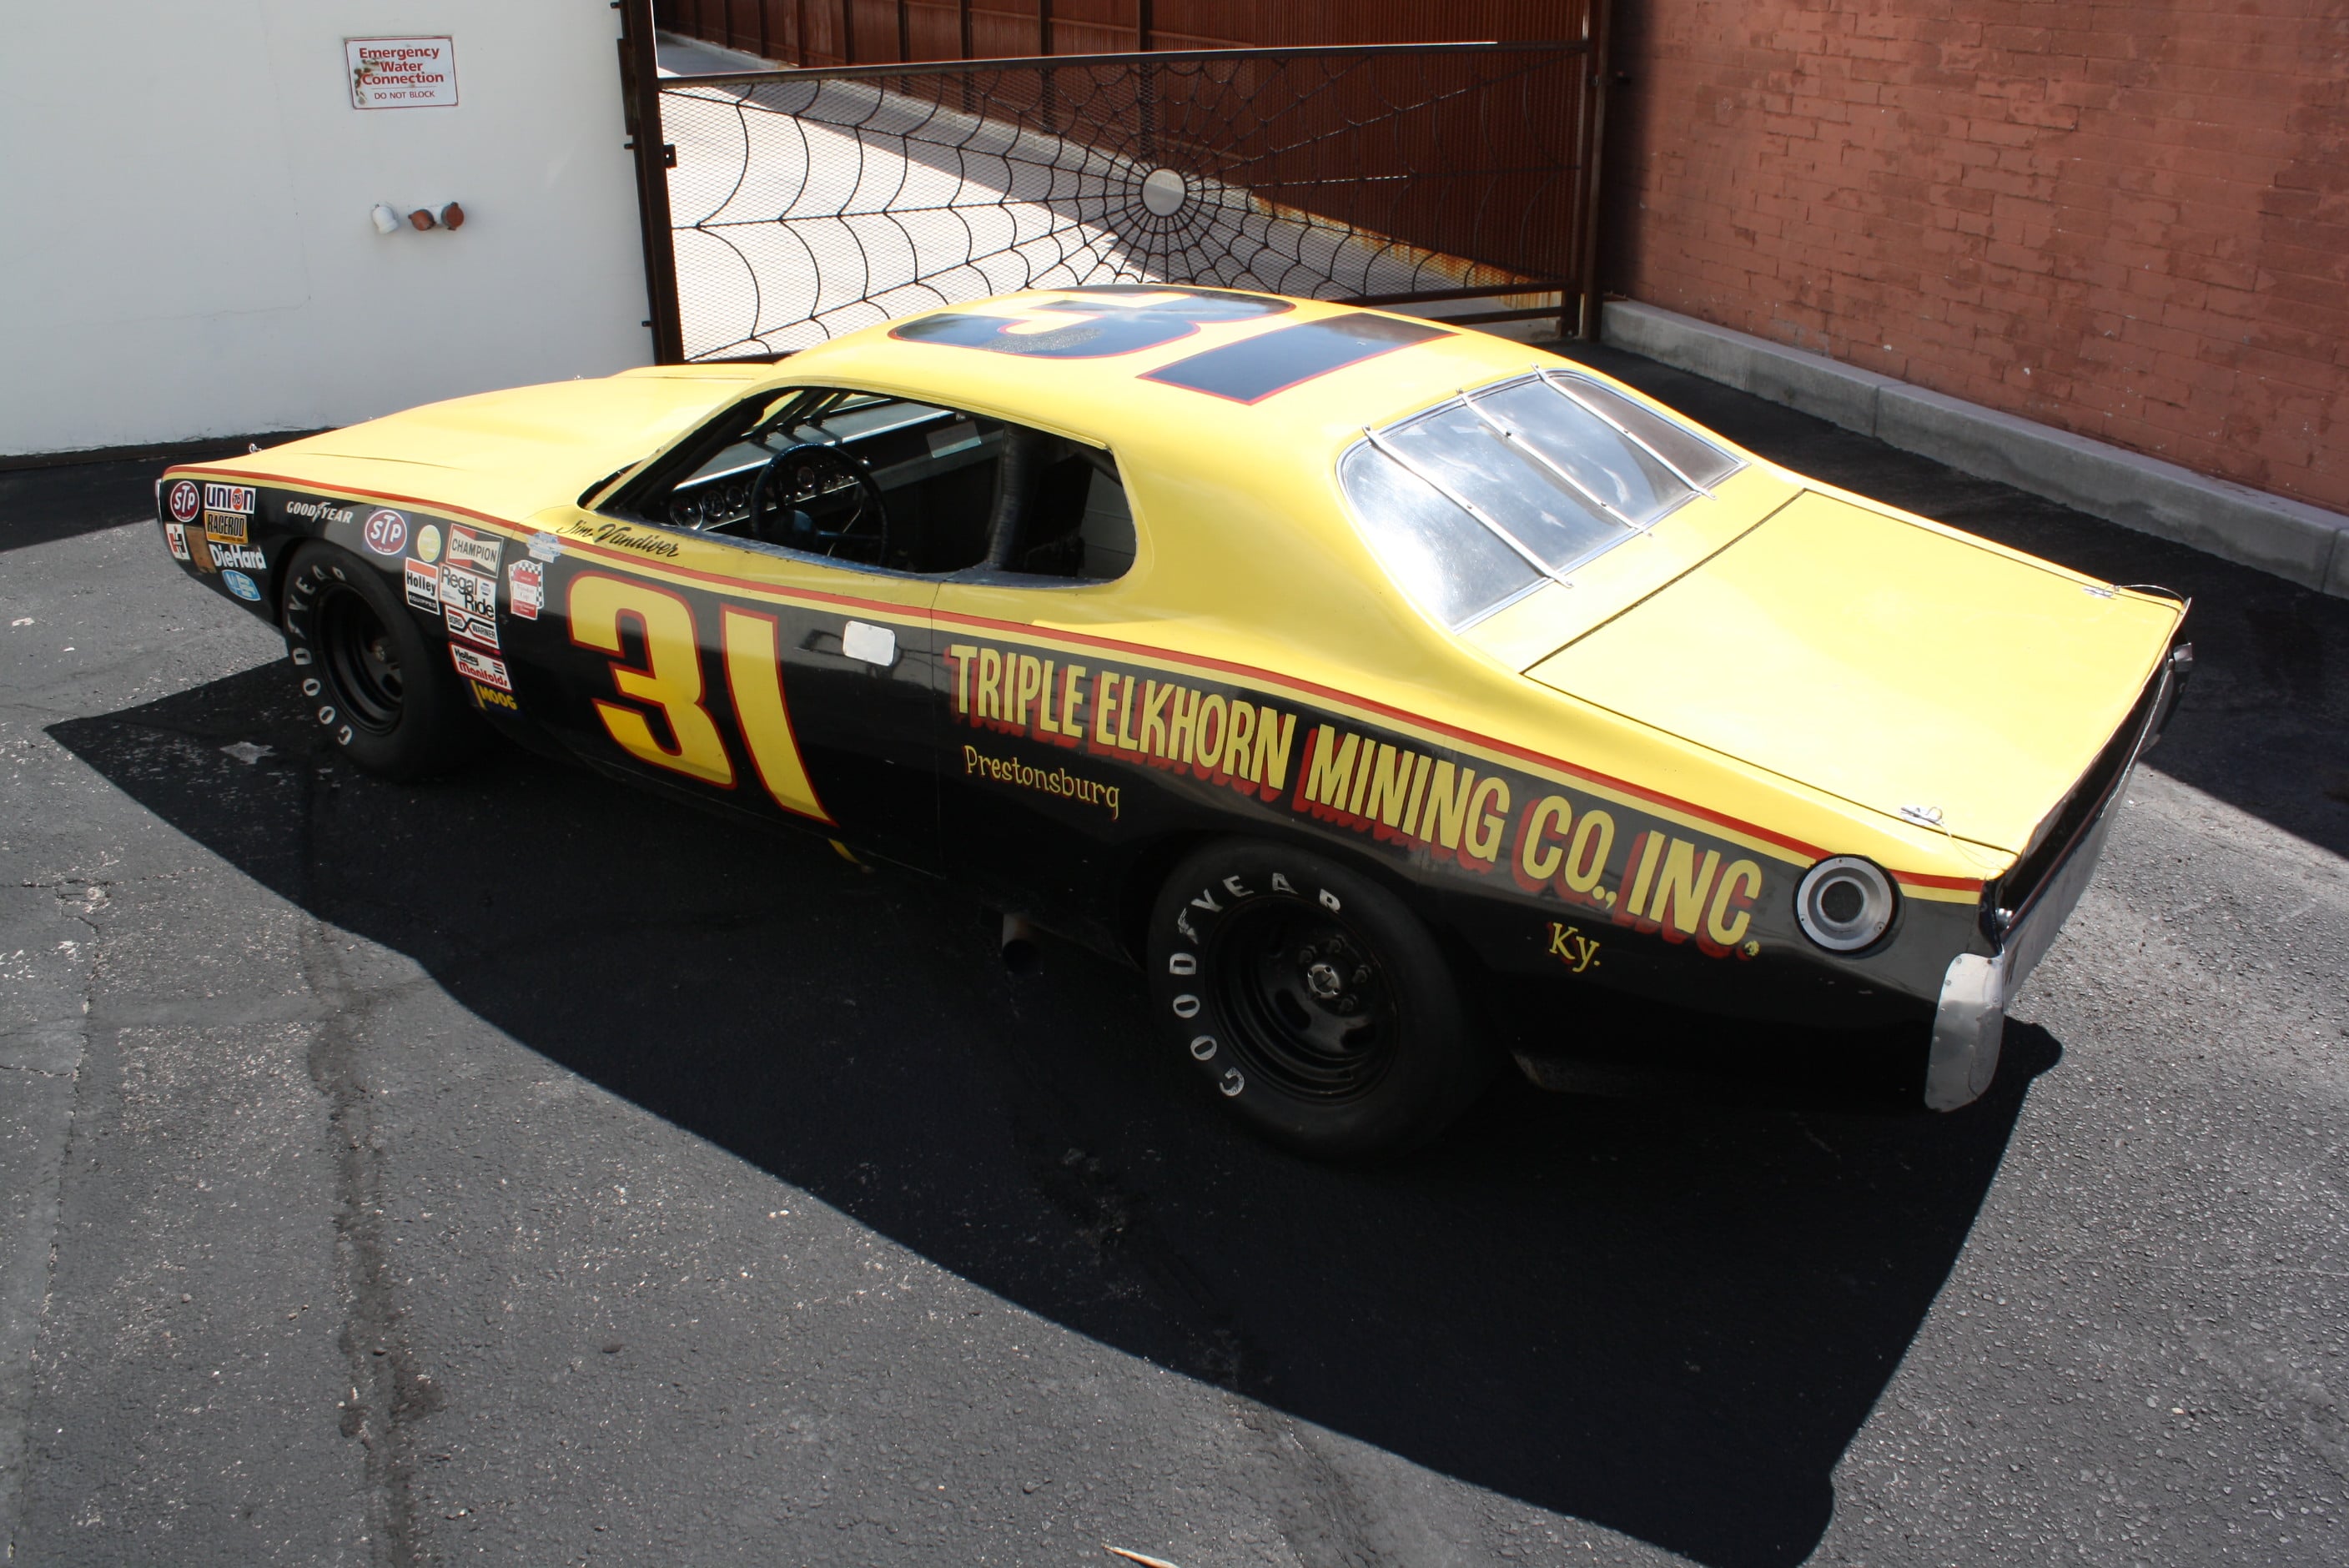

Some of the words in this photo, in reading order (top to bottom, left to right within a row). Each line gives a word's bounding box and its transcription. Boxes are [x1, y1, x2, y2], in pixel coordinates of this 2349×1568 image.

[359, 48, 440, 60] Emergency
[380, 62, 423, 72] Water
[362, 73, 444, 85] Connection
[174, 485, 195, 513] STP
[287, 501, 354, 524] GOODYEAR
[208, 514, 245, 537] RACEROD
[370, 515, 402, 545] STP
[556, 520, 594, 537] Jim
[594, 524, 679, 557] Vandiver
[209, 544, 267, 570] DieHard
[451, 538, 497, 563] CHAMPION
[406, 570, 436, 596] Holley
[441, 566, 478, 596] Regal
[465, 593, 495, 618] Ride
[565, 570, 840, 827] 31
[948, 644, 1087, 742] TRIPLE
[1094, 671, 1298, 794] ELKHORN
[1301, 723, 1511, 866] MINING
[964, 745, 1120, 820] Prestonsburg
[1547, 922, 1601, 972] Ky.
[1169, 872, 1341, 1097] GOODYEAR
